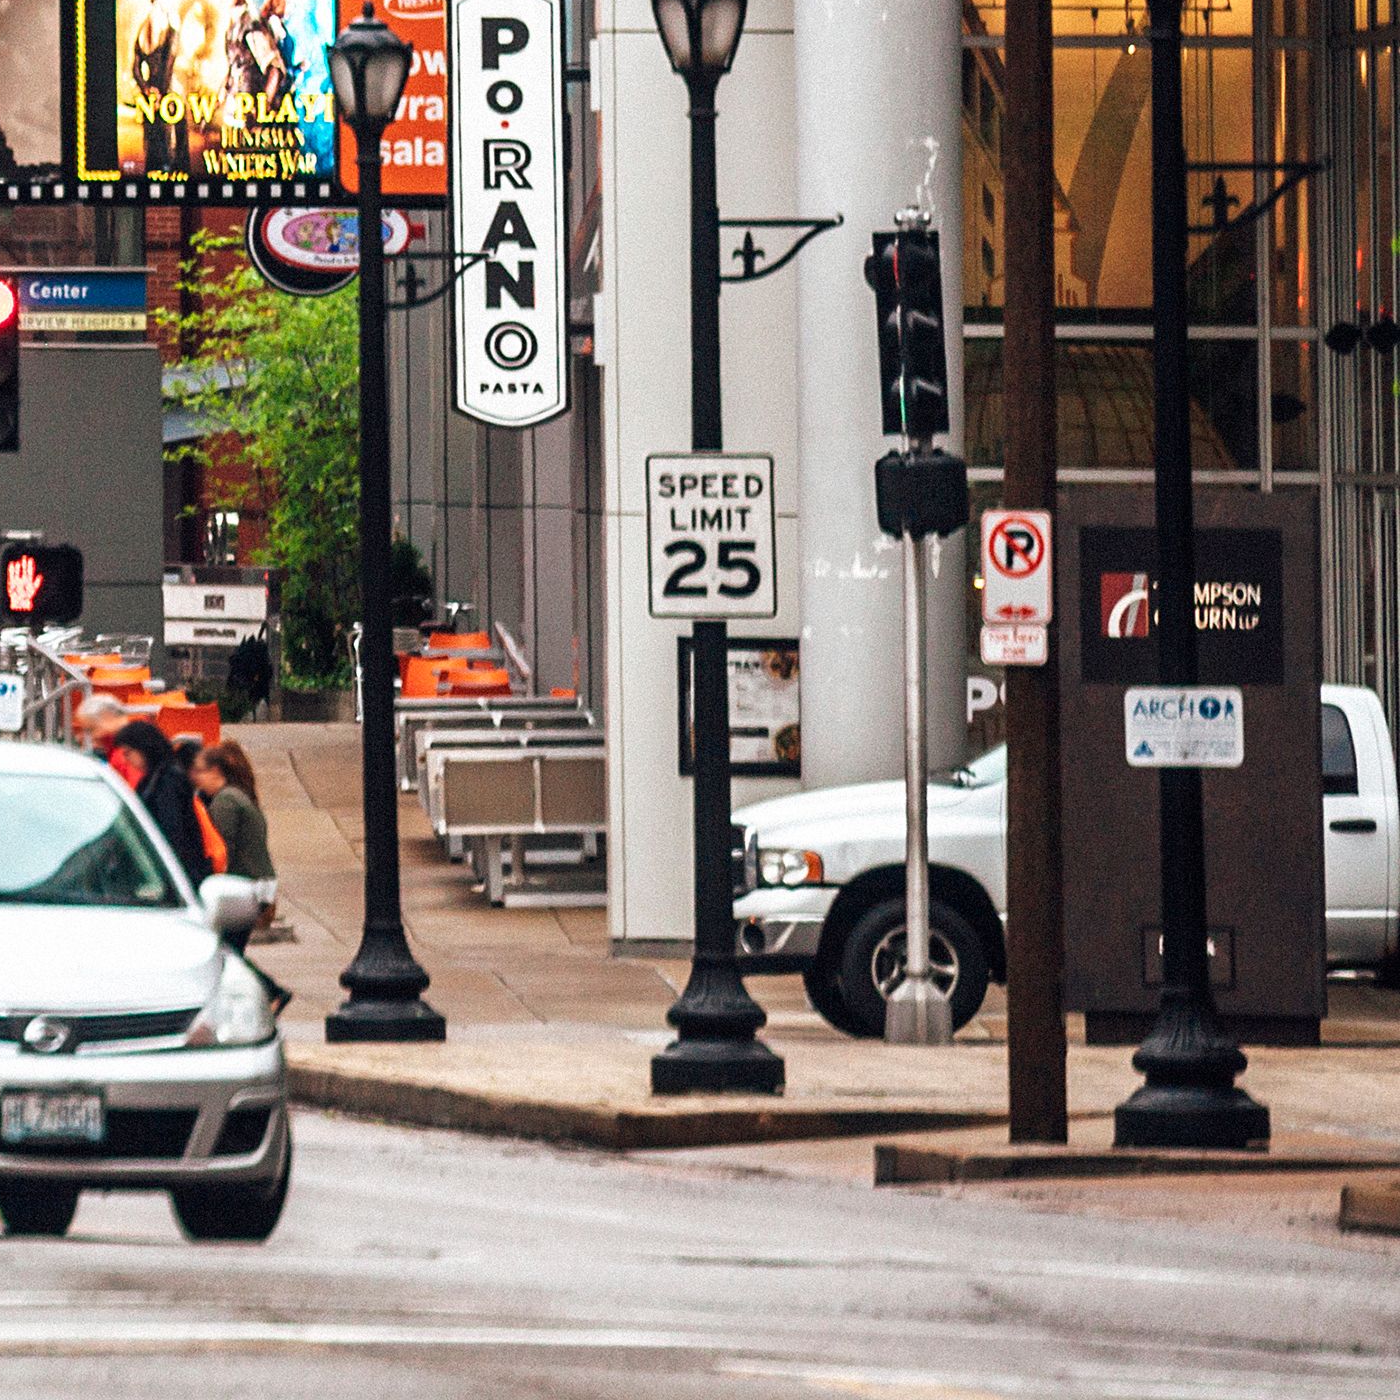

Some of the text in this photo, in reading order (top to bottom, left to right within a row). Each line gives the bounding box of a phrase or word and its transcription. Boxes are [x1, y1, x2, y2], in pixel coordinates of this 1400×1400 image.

[134, 91, 218, 124] NOW
[28, 281, 89, 300] Center
[479, 382, 544, 395] PASTA
[658, 474, 764, 499] SPEED
[669, 506, 752, 532] LIMIT
[662, 539, 762, 599] 25
[1192, 581, 1262, 608] MPSON
